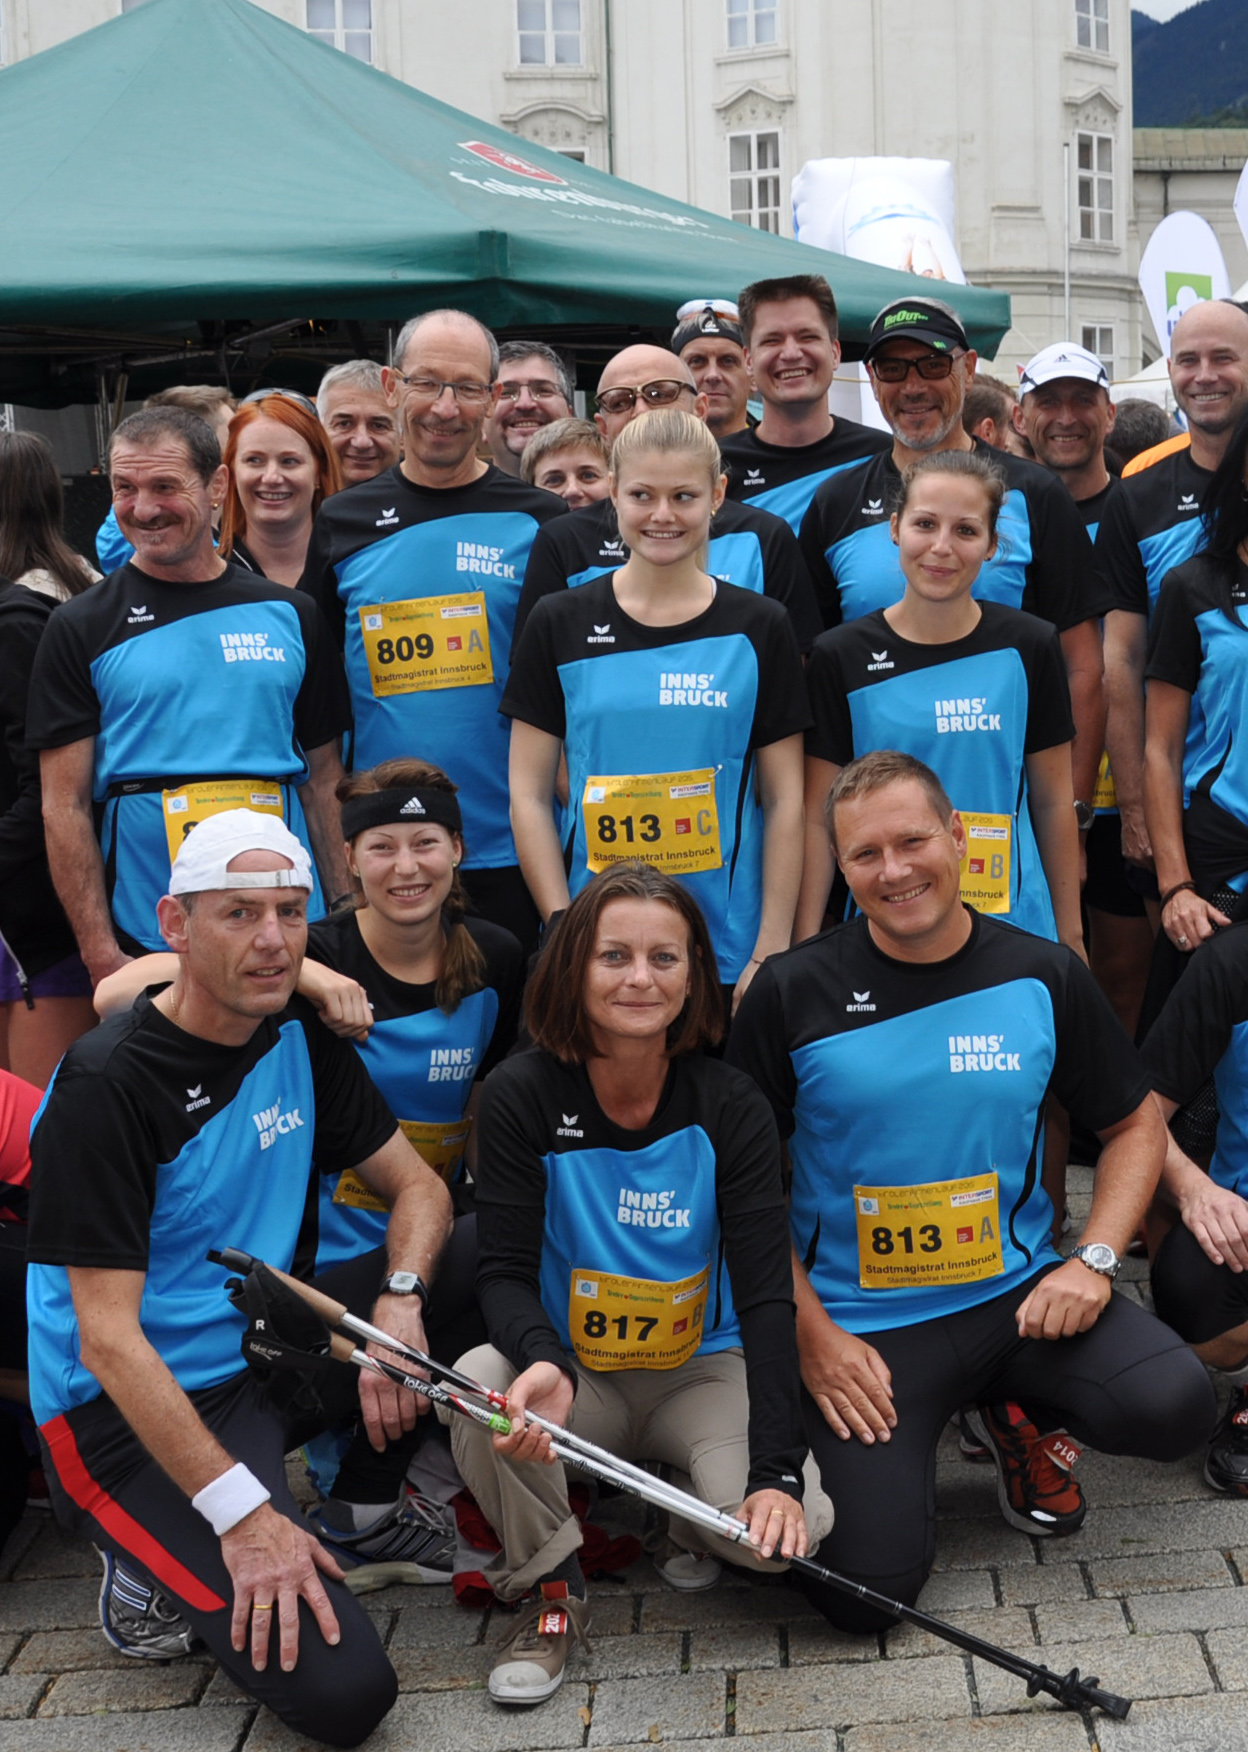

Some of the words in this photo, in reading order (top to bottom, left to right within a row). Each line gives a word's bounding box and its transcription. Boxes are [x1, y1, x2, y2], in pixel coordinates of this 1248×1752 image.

[743, 477, 766, 486] erima
[1177, 502, 1200, 511] erima
[375, 516, 400, 527] erima
[456, 541, 504, 562] INNS'
[598, 549, 625, 557] erima
[456, 556, 516, 580] BRUCK
[126, 613, 155, 624] erima
[219, 633, 269, 648] INNS'
[376, 633, 435, 665] 809
[467, 629, 485, 654] A
[587, 635, 616, 644] erima
[222, 646, 287, 663] BRUCK
[374, 666, 438, 684] Stadtmagistrat
[439, 661, 487, 675] Innsbruck
[867, 660, 895, 671] erima
[660, 673, 715, 690] INNS'
[659, 689, 728, 708] BRUCK
[934, 698, 987, 717] INNS'
[936, 713, 1001, 734] BRUCK
[400, 806, 426, 815] adidas
[597, 814, 662, 844] 813
[696, 809, 713, 836] C
[593, 851, 664, 862] Stadtmagistrat
[666, 846, 716, 861] Innsbruck
[990, 853, 1004, 879] B
[958, 889, 1004, 899] nnsbruck
[846, 1002, 877, 1012] erima
[948, 1034, 1004, 1054] INNS'
[949, 1052, 1021, 1073] BRUCK
[186, 1096, 211, 1112] erima
[259, 1108, 305, 1151] BRCK
[557, 1127, 584, 1138] erima
[618, 1187, 676, 1210] INNS'
[617, 1205, 691, 1229] BRUCK
[872, 1224, 943, 1256] 813
[979, 1216, 995, 1244] A
[865, 1263, 945, 1275] Stadtmagistrat
[947, 1251, 998, 1270] Innsbruck
[255, 1319, 266, 1331] R
[583, 1310, 659, 1342] 817
[691, 1302, 703, 1330] B
[575, 1342, 656, 1360] Stadtmagistrat
[658, 1332, 700, 1359] Innsbruck
